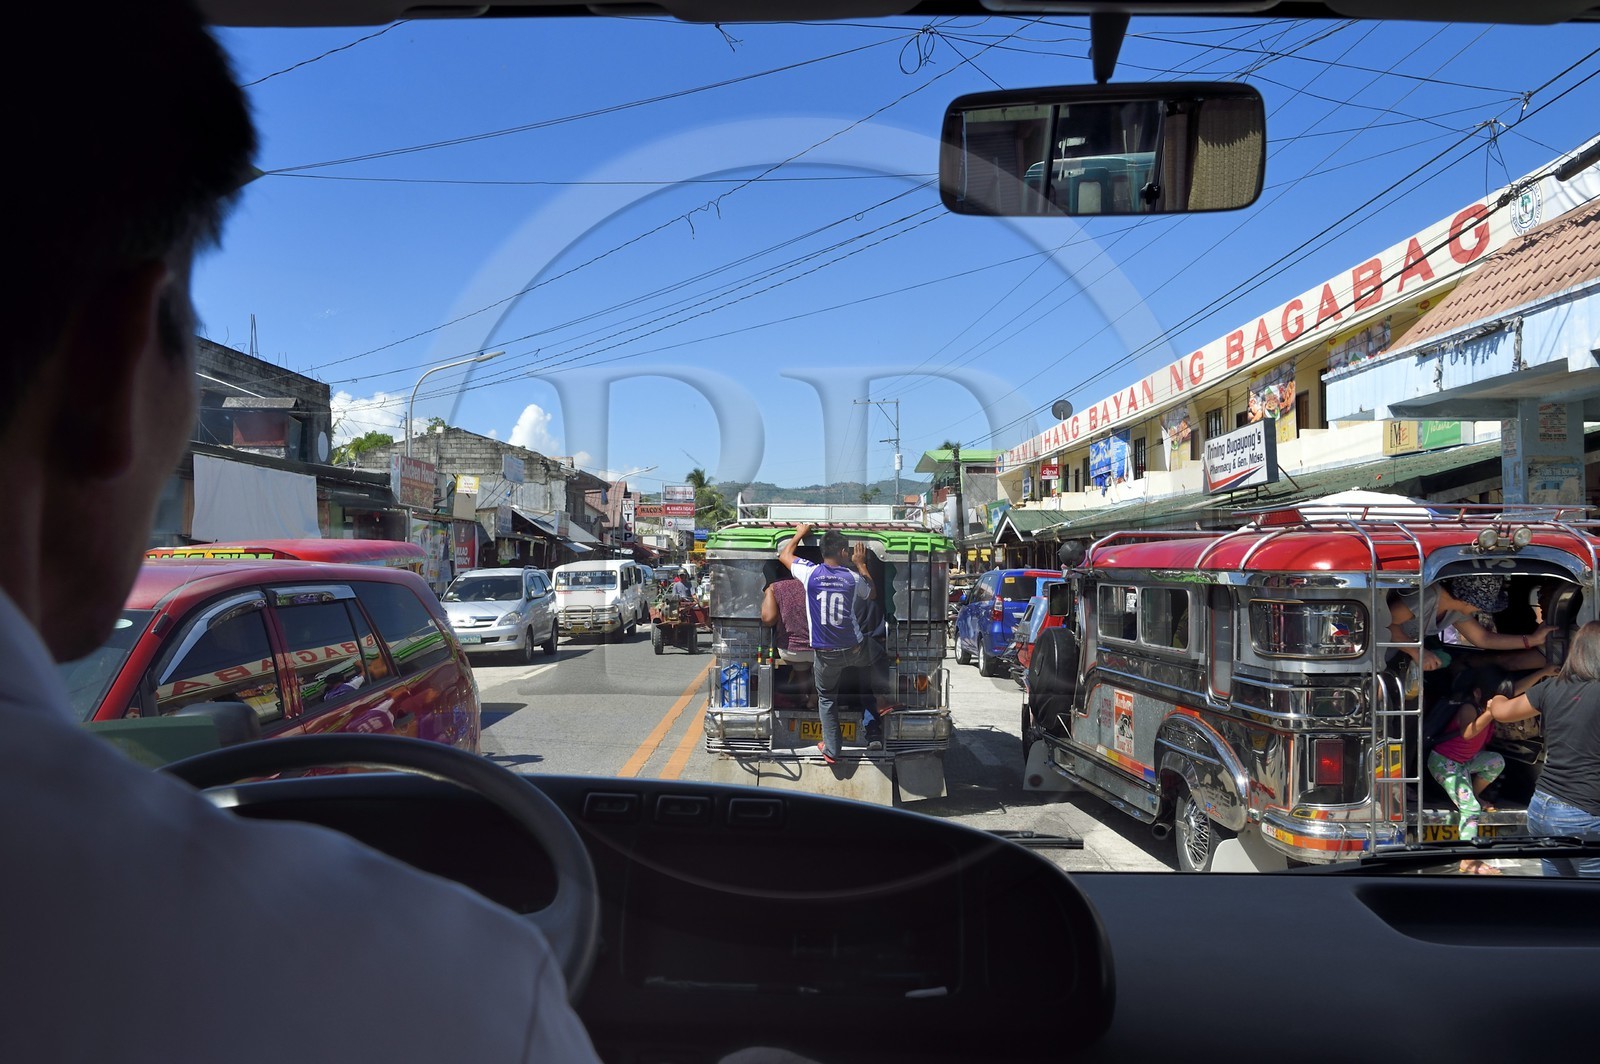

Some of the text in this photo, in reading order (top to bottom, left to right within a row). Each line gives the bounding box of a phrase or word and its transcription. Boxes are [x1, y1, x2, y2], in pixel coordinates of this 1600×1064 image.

[1088, 378, 1154, 431] BAYAN
[1169, 350, 1205, 395] NG
[1226, 202, 1491, 370] BAGABAG
[1227, 428, 1261, 457] Bugayong's
[1210, 463, 1232, 475] Pharmacy
[816, 590, 845, 626] 10
